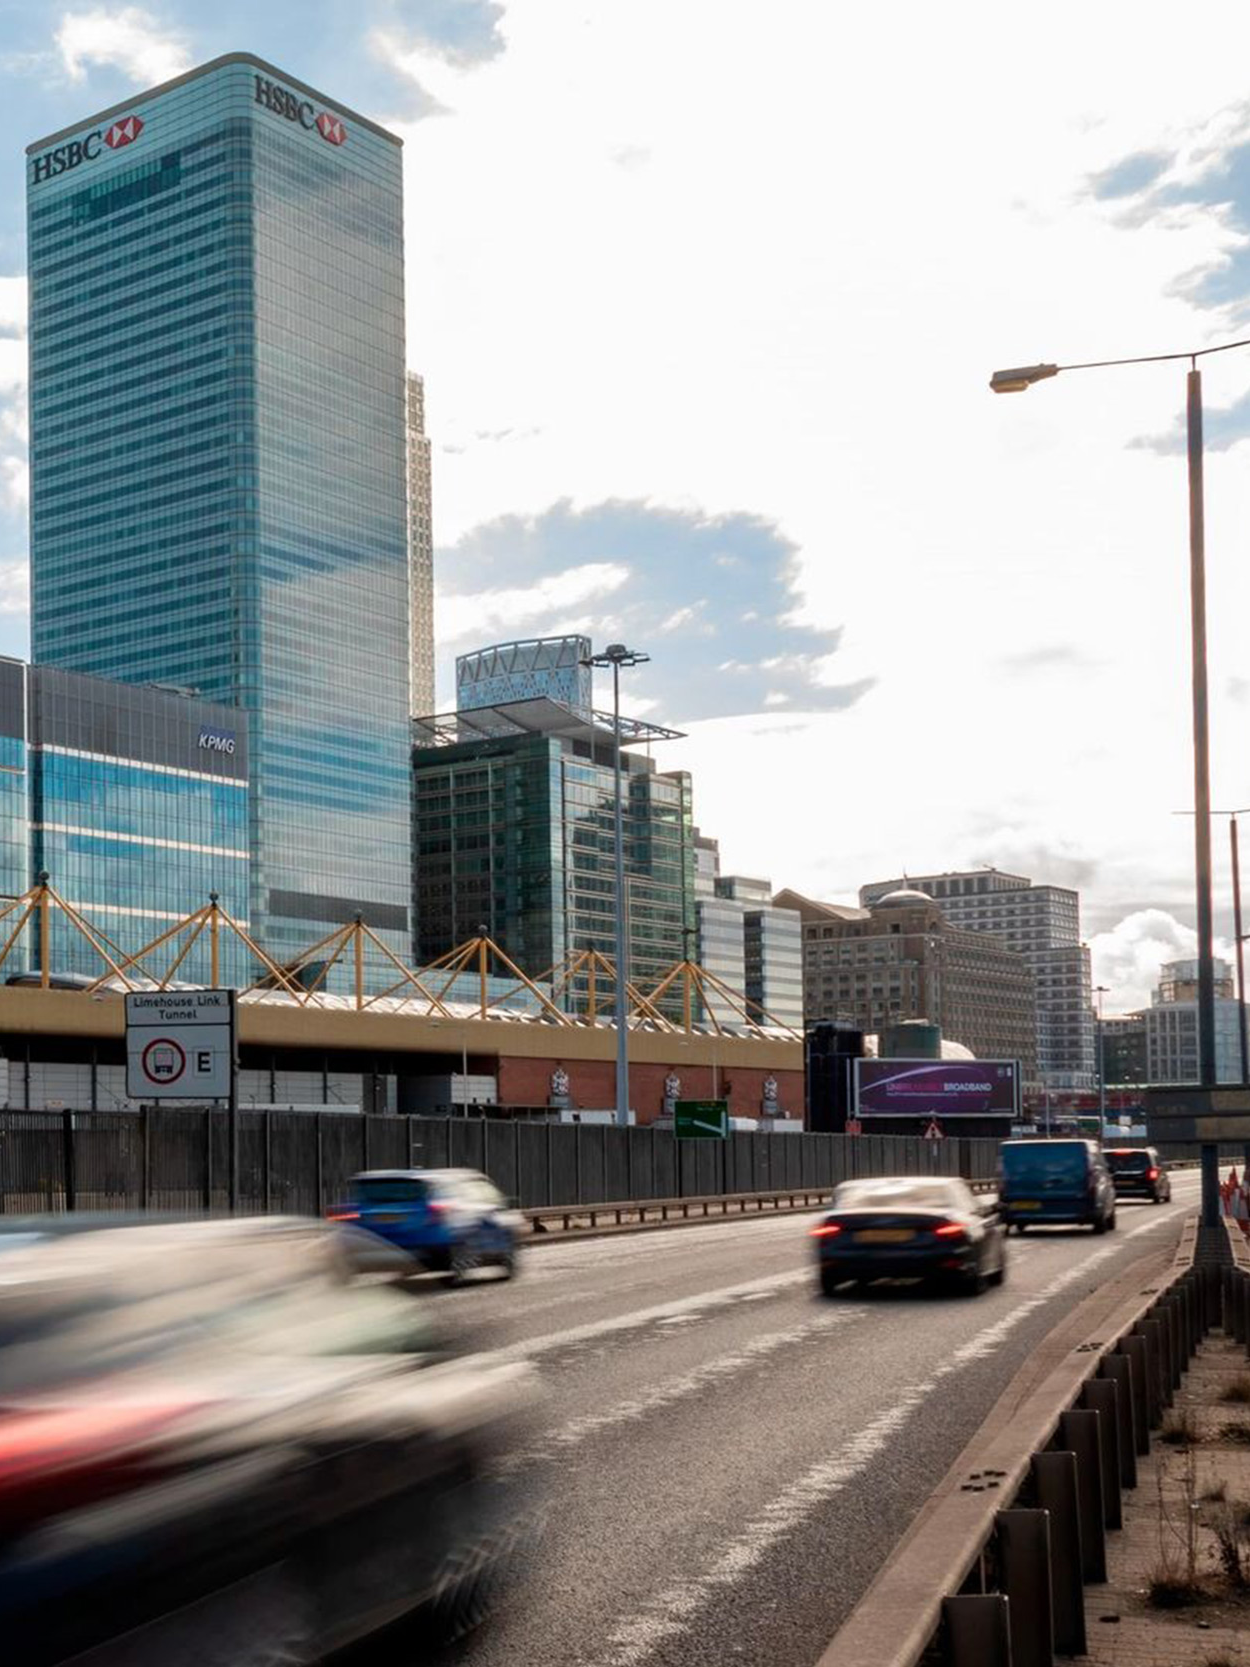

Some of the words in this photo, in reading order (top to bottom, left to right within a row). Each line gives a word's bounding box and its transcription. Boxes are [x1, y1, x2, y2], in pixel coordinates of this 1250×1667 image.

[252, 74, 315, 130] HSBC
[32, 131, 102, 185] HSBC
[198, 732, 236, 754] KPMG
[133, 997, 193, 1008] Limehouse
[197, 995, 222, 1006] Link
[158, 1009, 198, 1020] Tunnel
[197, 1051, 211, 1073] E
[943, 1082, 993, 1092] BROADBAND
